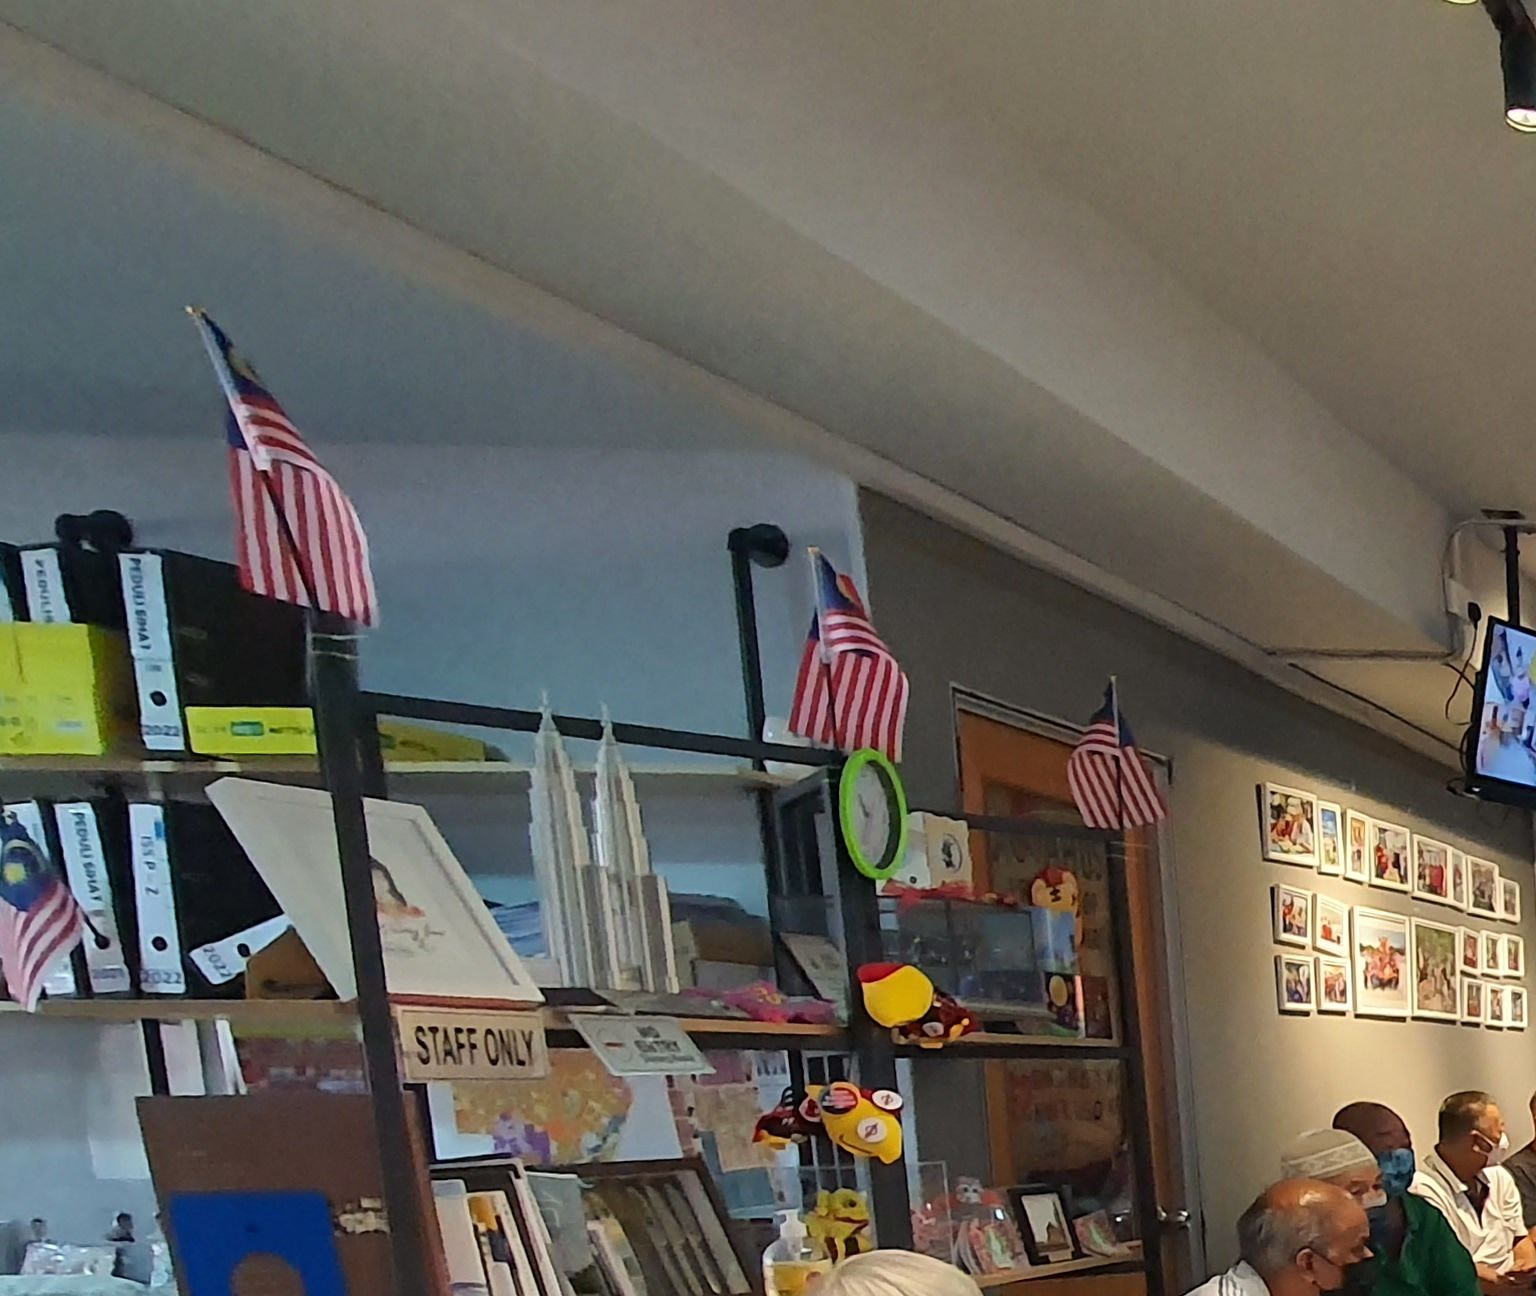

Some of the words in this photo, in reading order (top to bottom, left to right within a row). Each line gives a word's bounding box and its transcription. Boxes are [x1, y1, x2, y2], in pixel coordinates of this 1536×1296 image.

[141, 968, 182, 984] 2022
[202, 946, 233, 978] 2022
[414, 1026, 478, 1066] STAFF
[483, 1027, 534, 1067] ONLY
